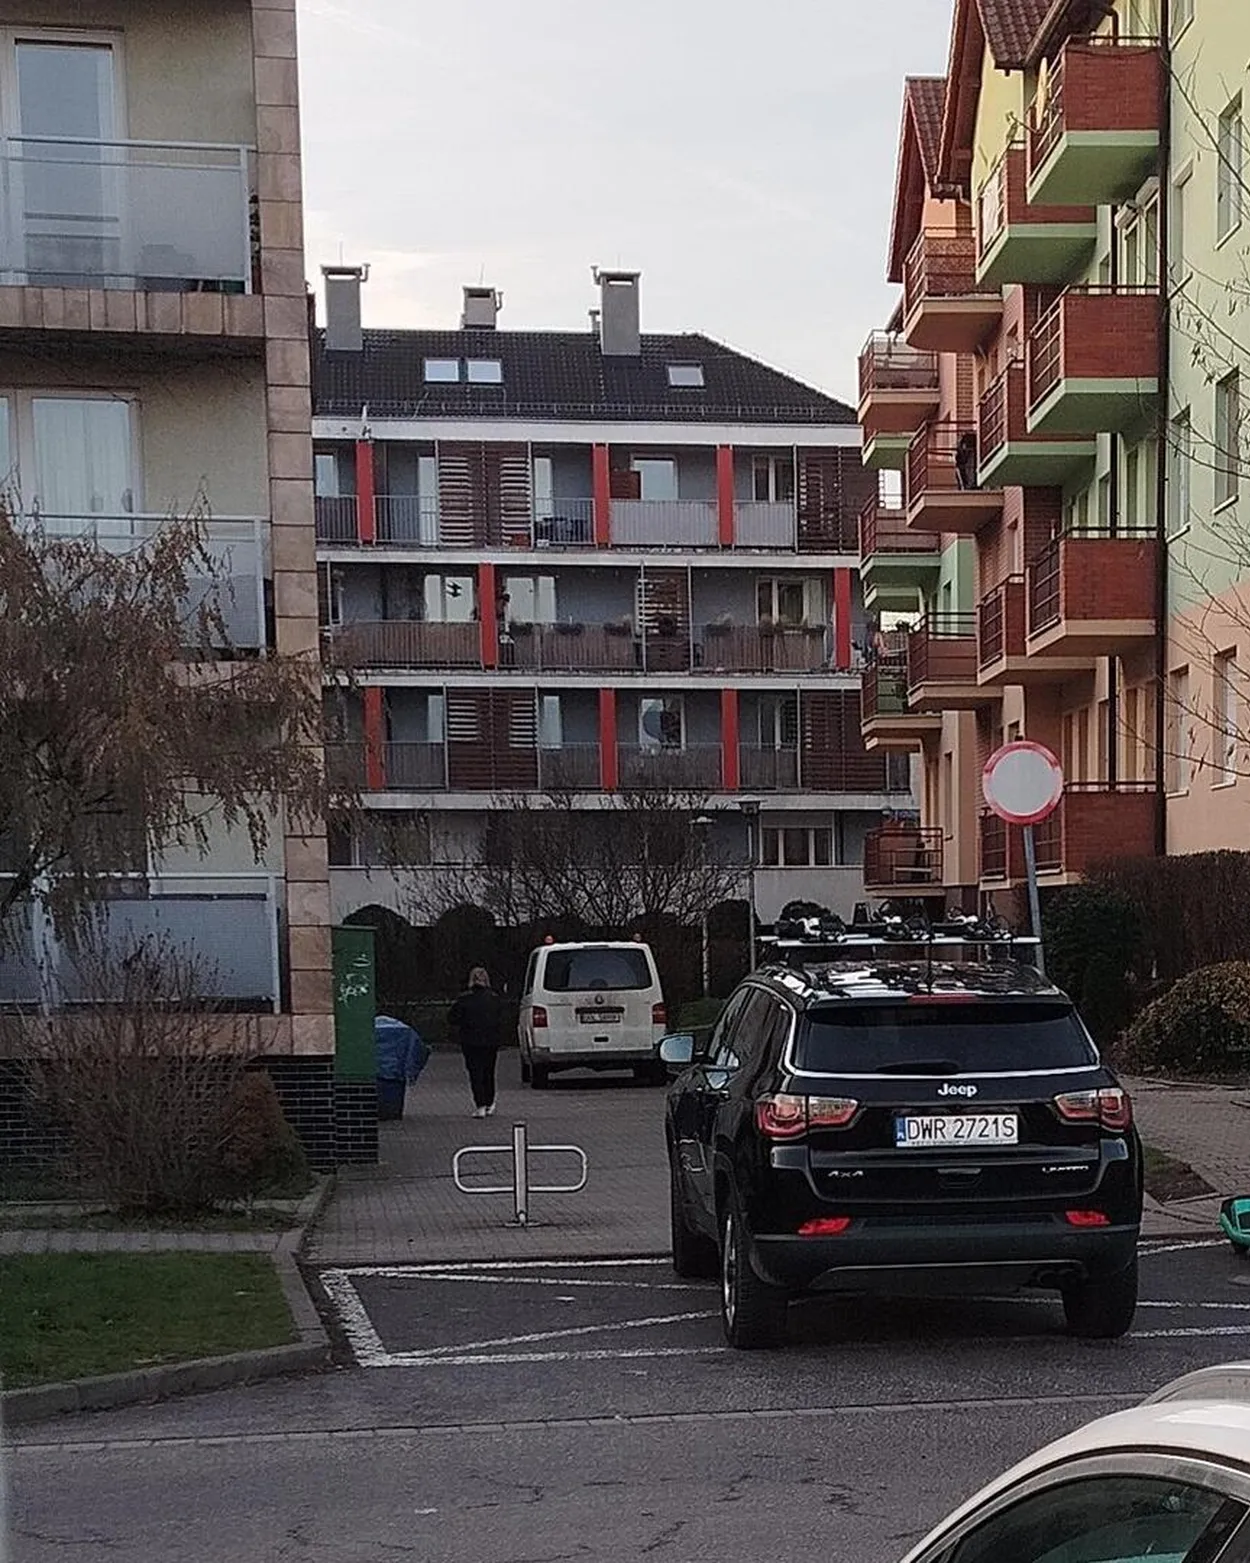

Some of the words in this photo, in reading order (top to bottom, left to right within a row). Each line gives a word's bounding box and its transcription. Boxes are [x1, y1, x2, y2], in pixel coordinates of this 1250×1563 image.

[937, 1083, 978, 1098] Jeep
[907, 1118, 946, 1140] DWR
[953, 1116, 1016, 1139] 2721S
